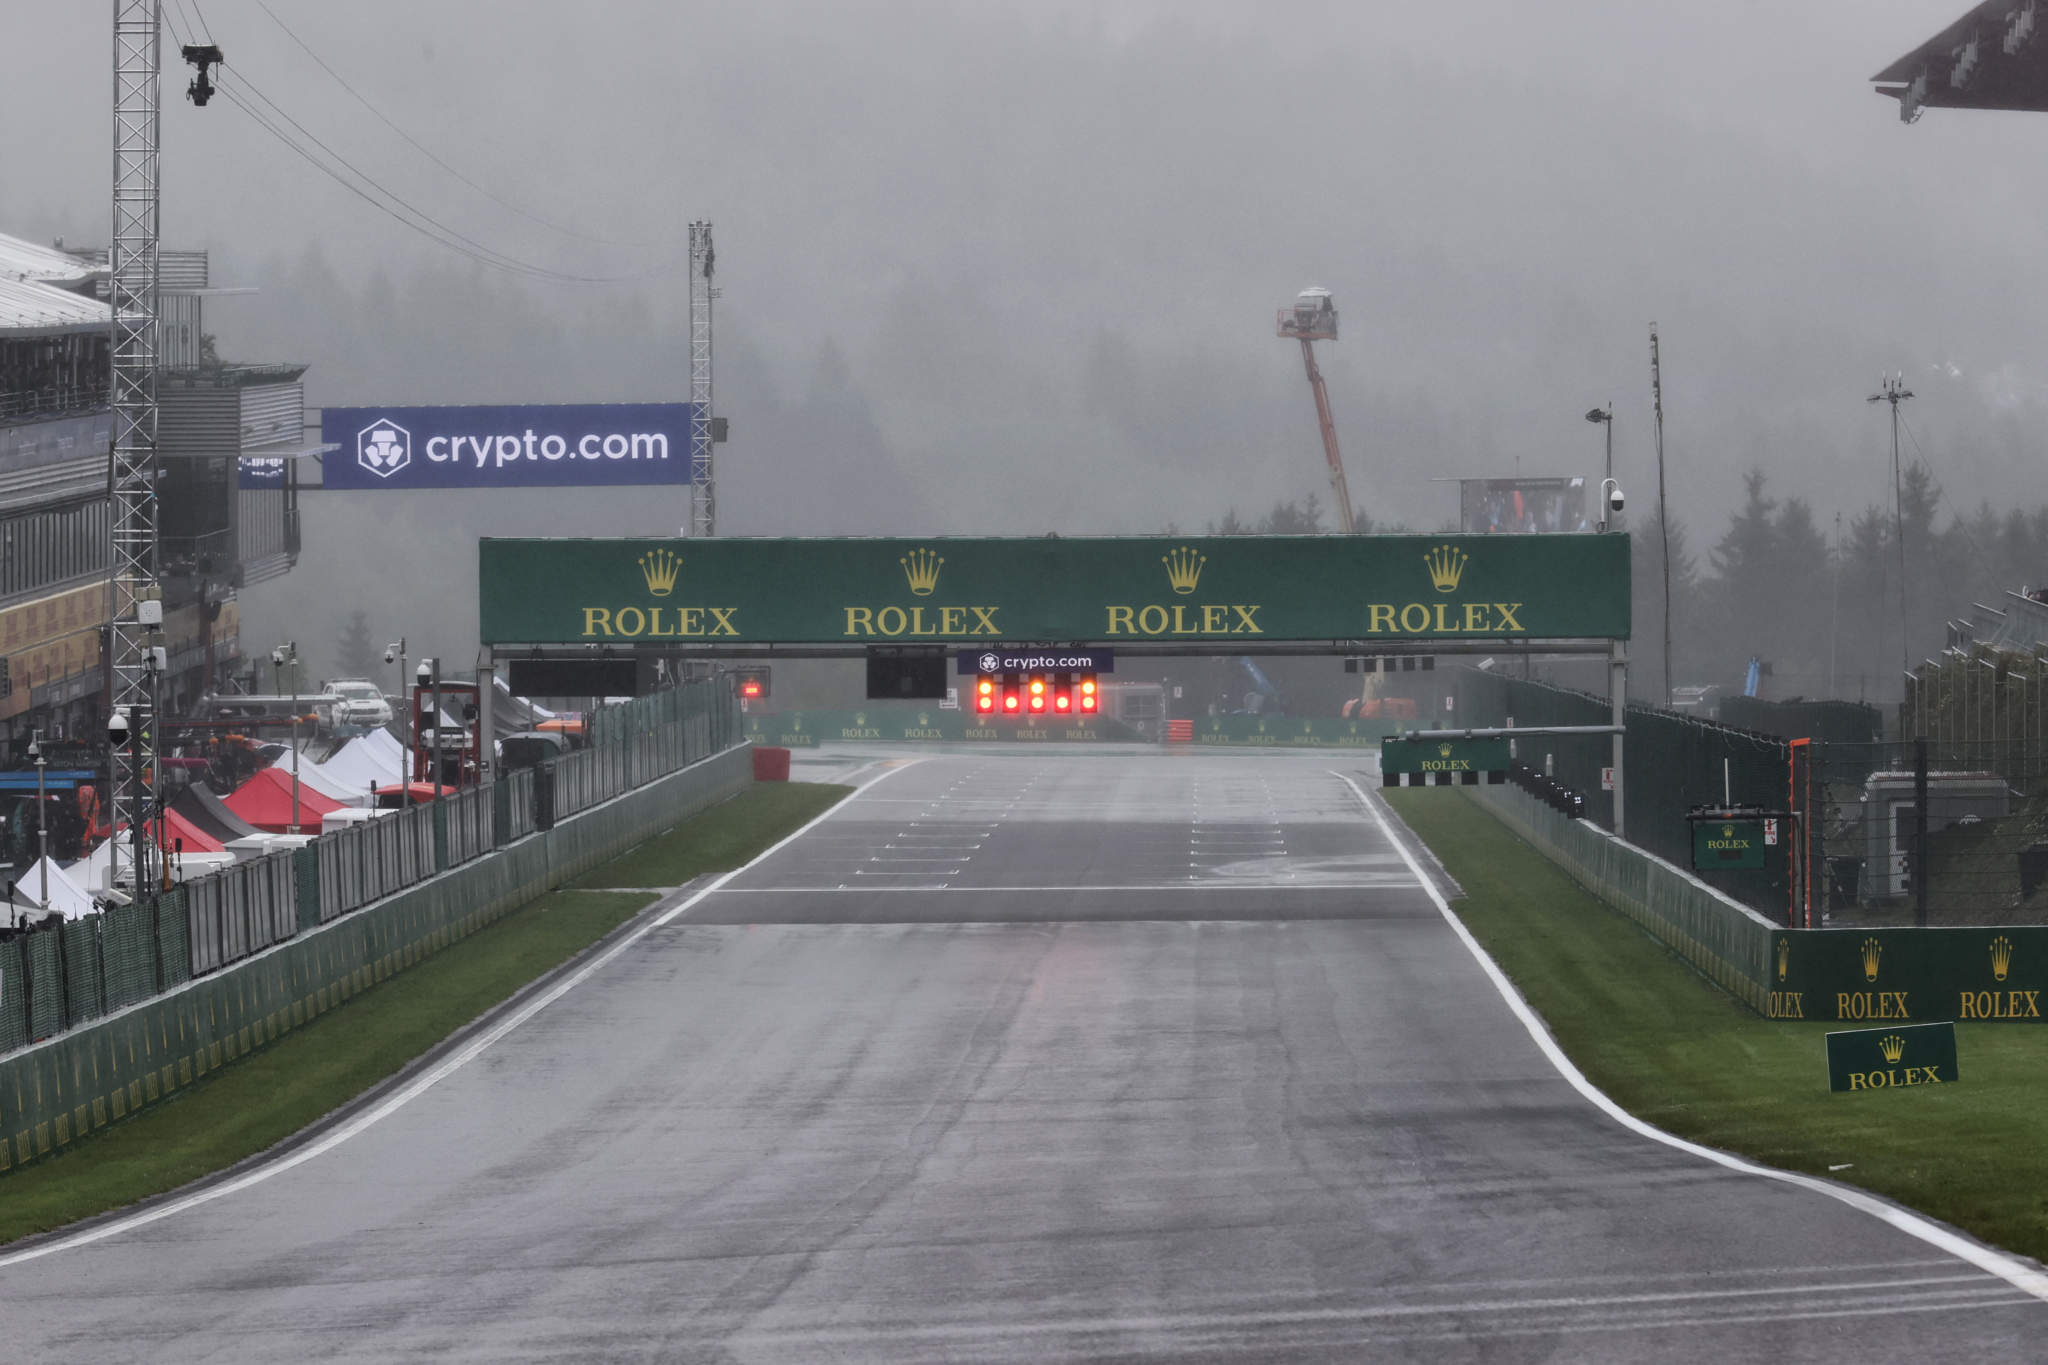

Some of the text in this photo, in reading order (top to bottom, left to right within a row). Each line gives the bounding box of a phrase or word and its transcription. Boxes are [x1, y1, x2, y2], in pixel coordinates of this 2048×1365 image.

[426, 428, 668, 468] crypto.com
[582, 606, 740, 636] ROLEX
[844, 606, 1002, 636] ROLEX
[1106, 605, 1264, 635] ROLEX
[1367, 603, 1525, 633] ROLEX
[1004, 655, 1092, 670] crypto.com
[841, 728, 880, 738] ROLEX
[904, 728, 943, 738] ROLEX
[965, 728, 998, 739] ROLEX
[1421, 759, 1471, 771] ROLEX
[1707, 839, 1750, 849] ROLEX
[1837, 991, 1909, 1019] ROLEX
[1959, 990, 2040, 1019] ROLEX
[1848, 1065, 1942, 1091] ROLEX
